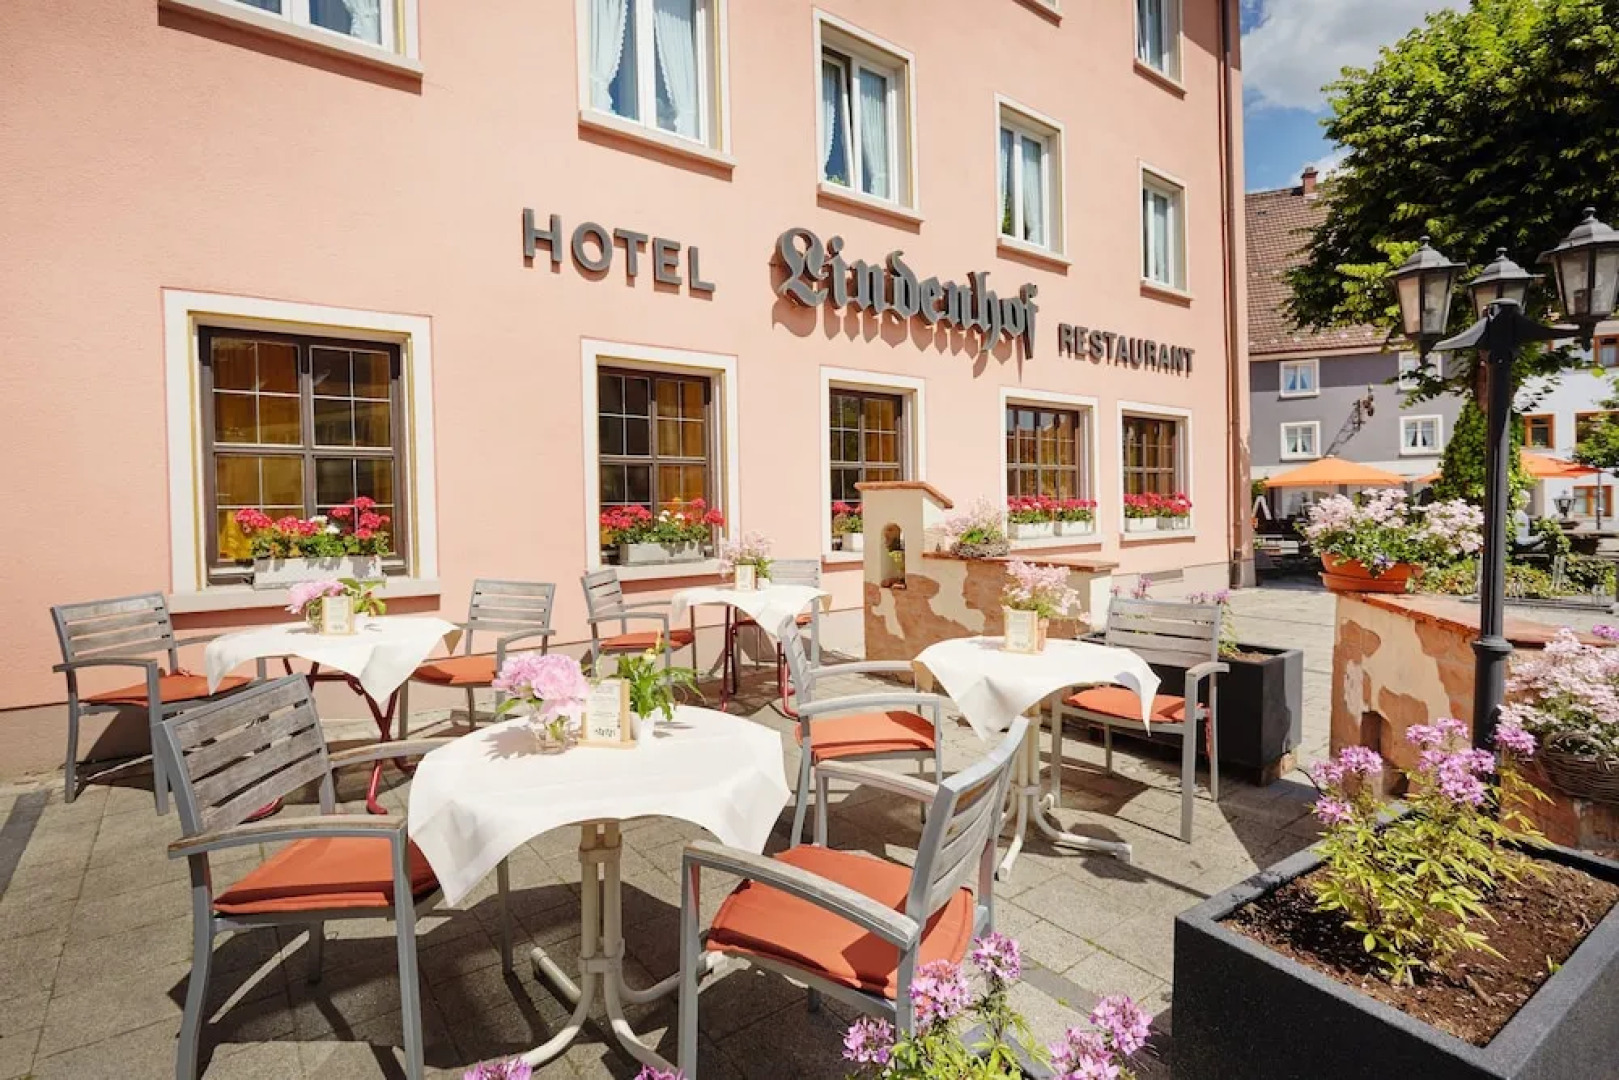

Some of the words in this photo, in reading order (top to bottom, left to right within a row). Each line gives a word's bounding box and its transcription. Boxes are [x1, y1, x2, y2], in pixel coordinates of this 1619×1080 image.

[522, 207, 716, 293] HOTEL
[775, 227, 1039, 360] Lindenhof
[1057, 322, 1196, 374] RESTAURANT
